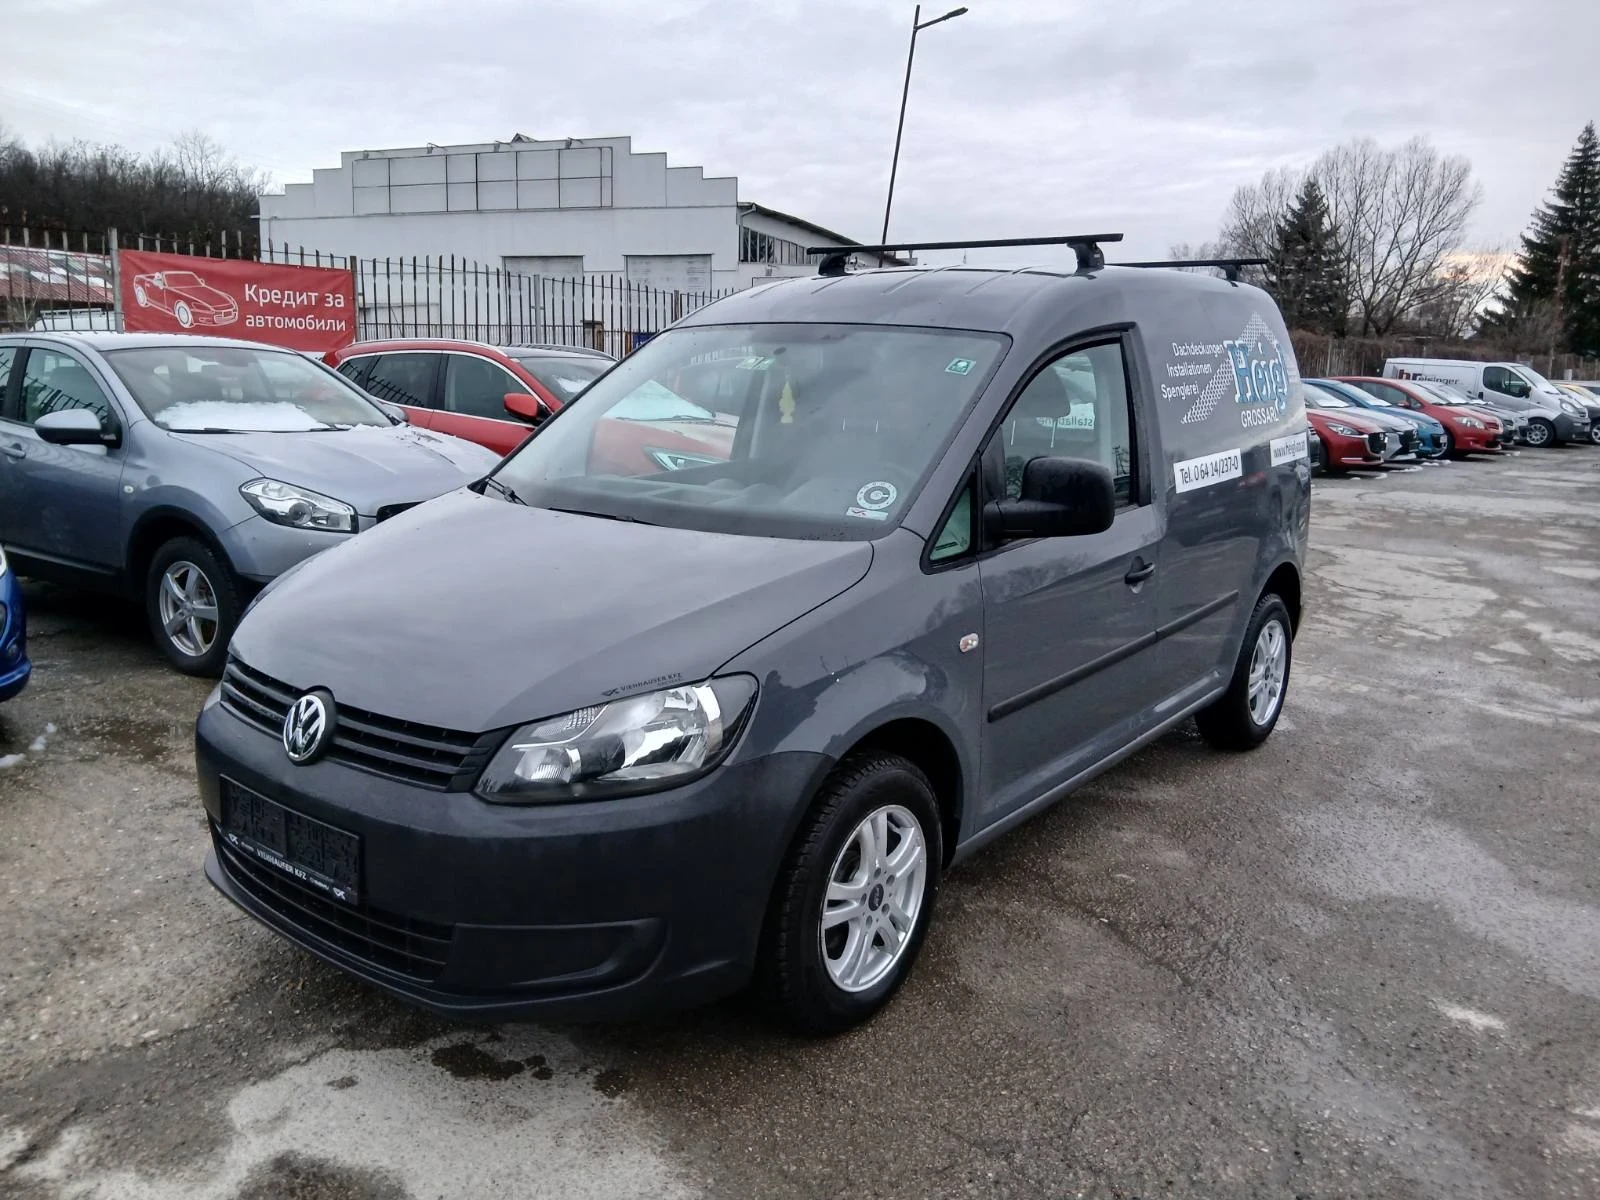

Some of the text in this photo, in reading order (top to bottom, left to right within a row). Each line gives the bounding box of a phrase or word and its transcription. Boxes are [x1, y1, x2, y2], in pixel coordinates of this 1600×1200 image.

[245, 283, 345, 308] Кредит за
[245, 313, 346, 331] автомобили
[1172, 342, 1224, 358] Dachdeckungen
[1166, 362, 1213, 377] Installationen
[1161, 380, 1199, 400] Spenglerei
[1180, 467, 1193, 485] Tel.
